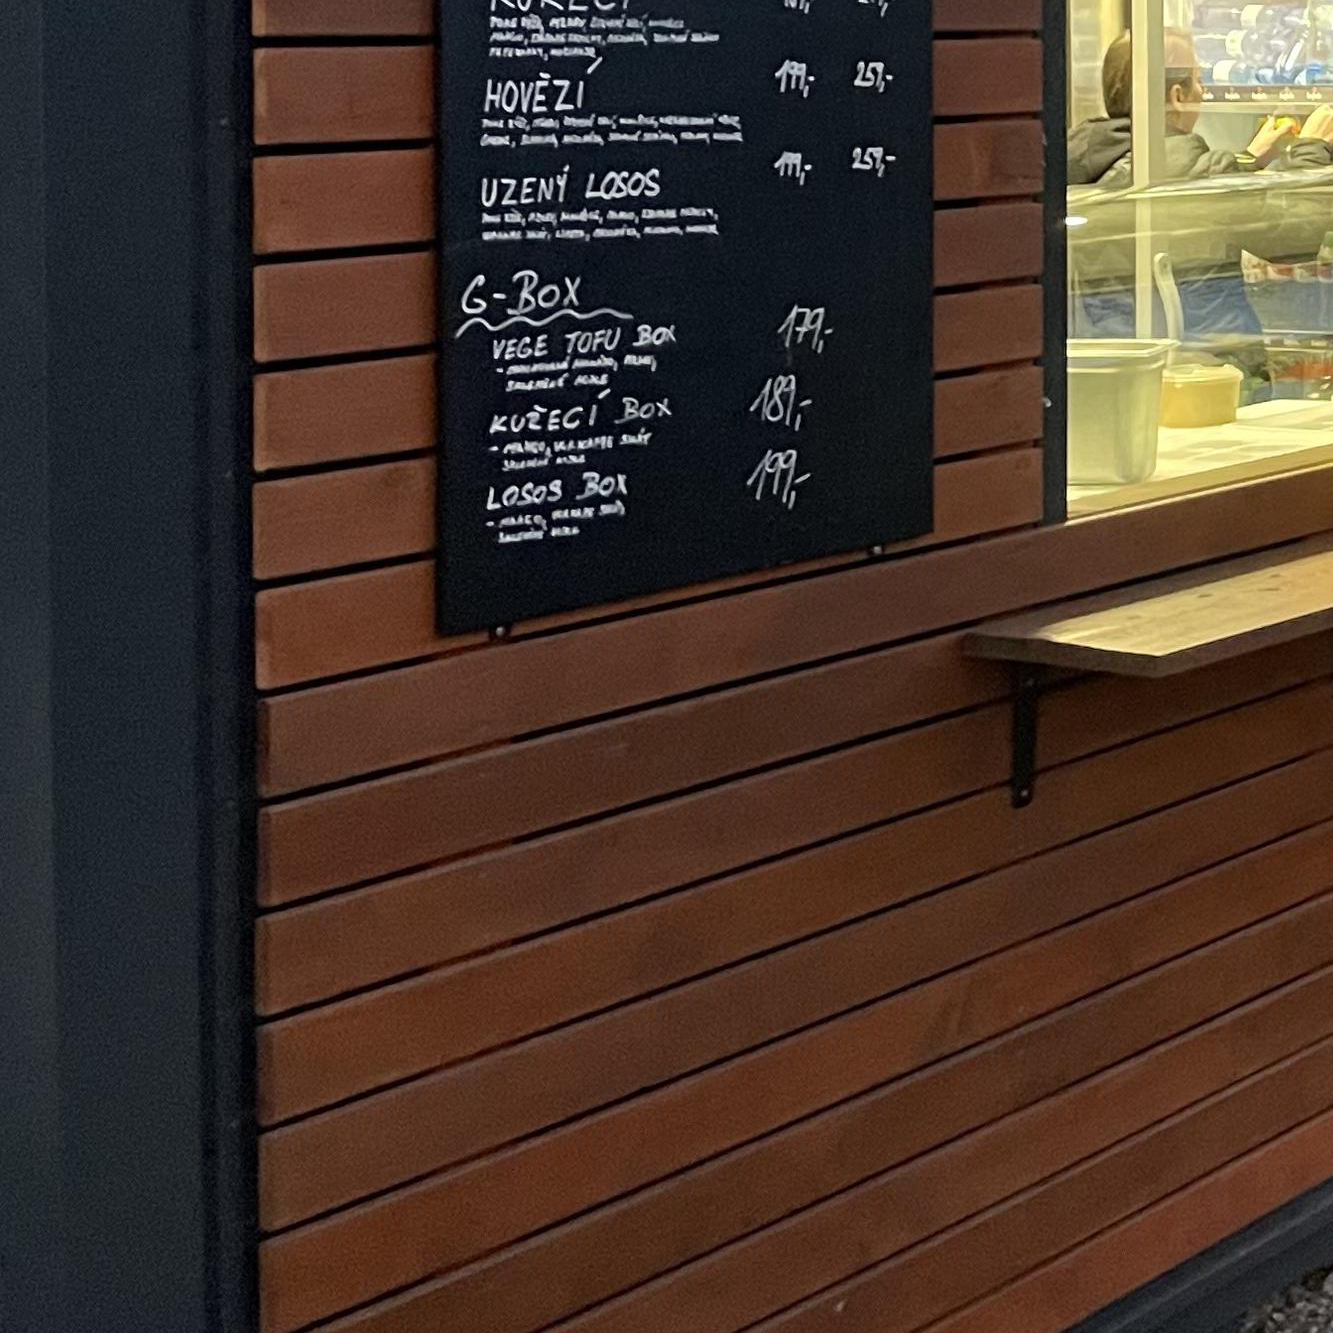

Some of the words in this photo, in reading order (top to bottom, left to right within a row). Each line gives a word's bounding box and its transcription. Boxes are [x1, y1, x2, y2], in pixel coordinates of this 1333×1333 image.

[483, 58, 602, 113] HOVĚZÍ
[481, 165, 570, 207] UZENÝ
[584, 168, 661, 200] LOSOS
[461, 269, 582, 316] G-BOX
[492, 333, 549, 361] VEGE
[564, 326, 621, 354] TOFU
[632, 323, 678, 347] BOX
[776, 303, 834, 354] 179,-
[489, 388, 611, 435] KUŘECÍ
[614, 396, 673, 425] BOX
[749, 373, 813, 432] 189,-
[486, 478, 563, 511] LOSOS
[575, 471, 628, 501] BOX
[746, 448, 813, 511] 199,-
